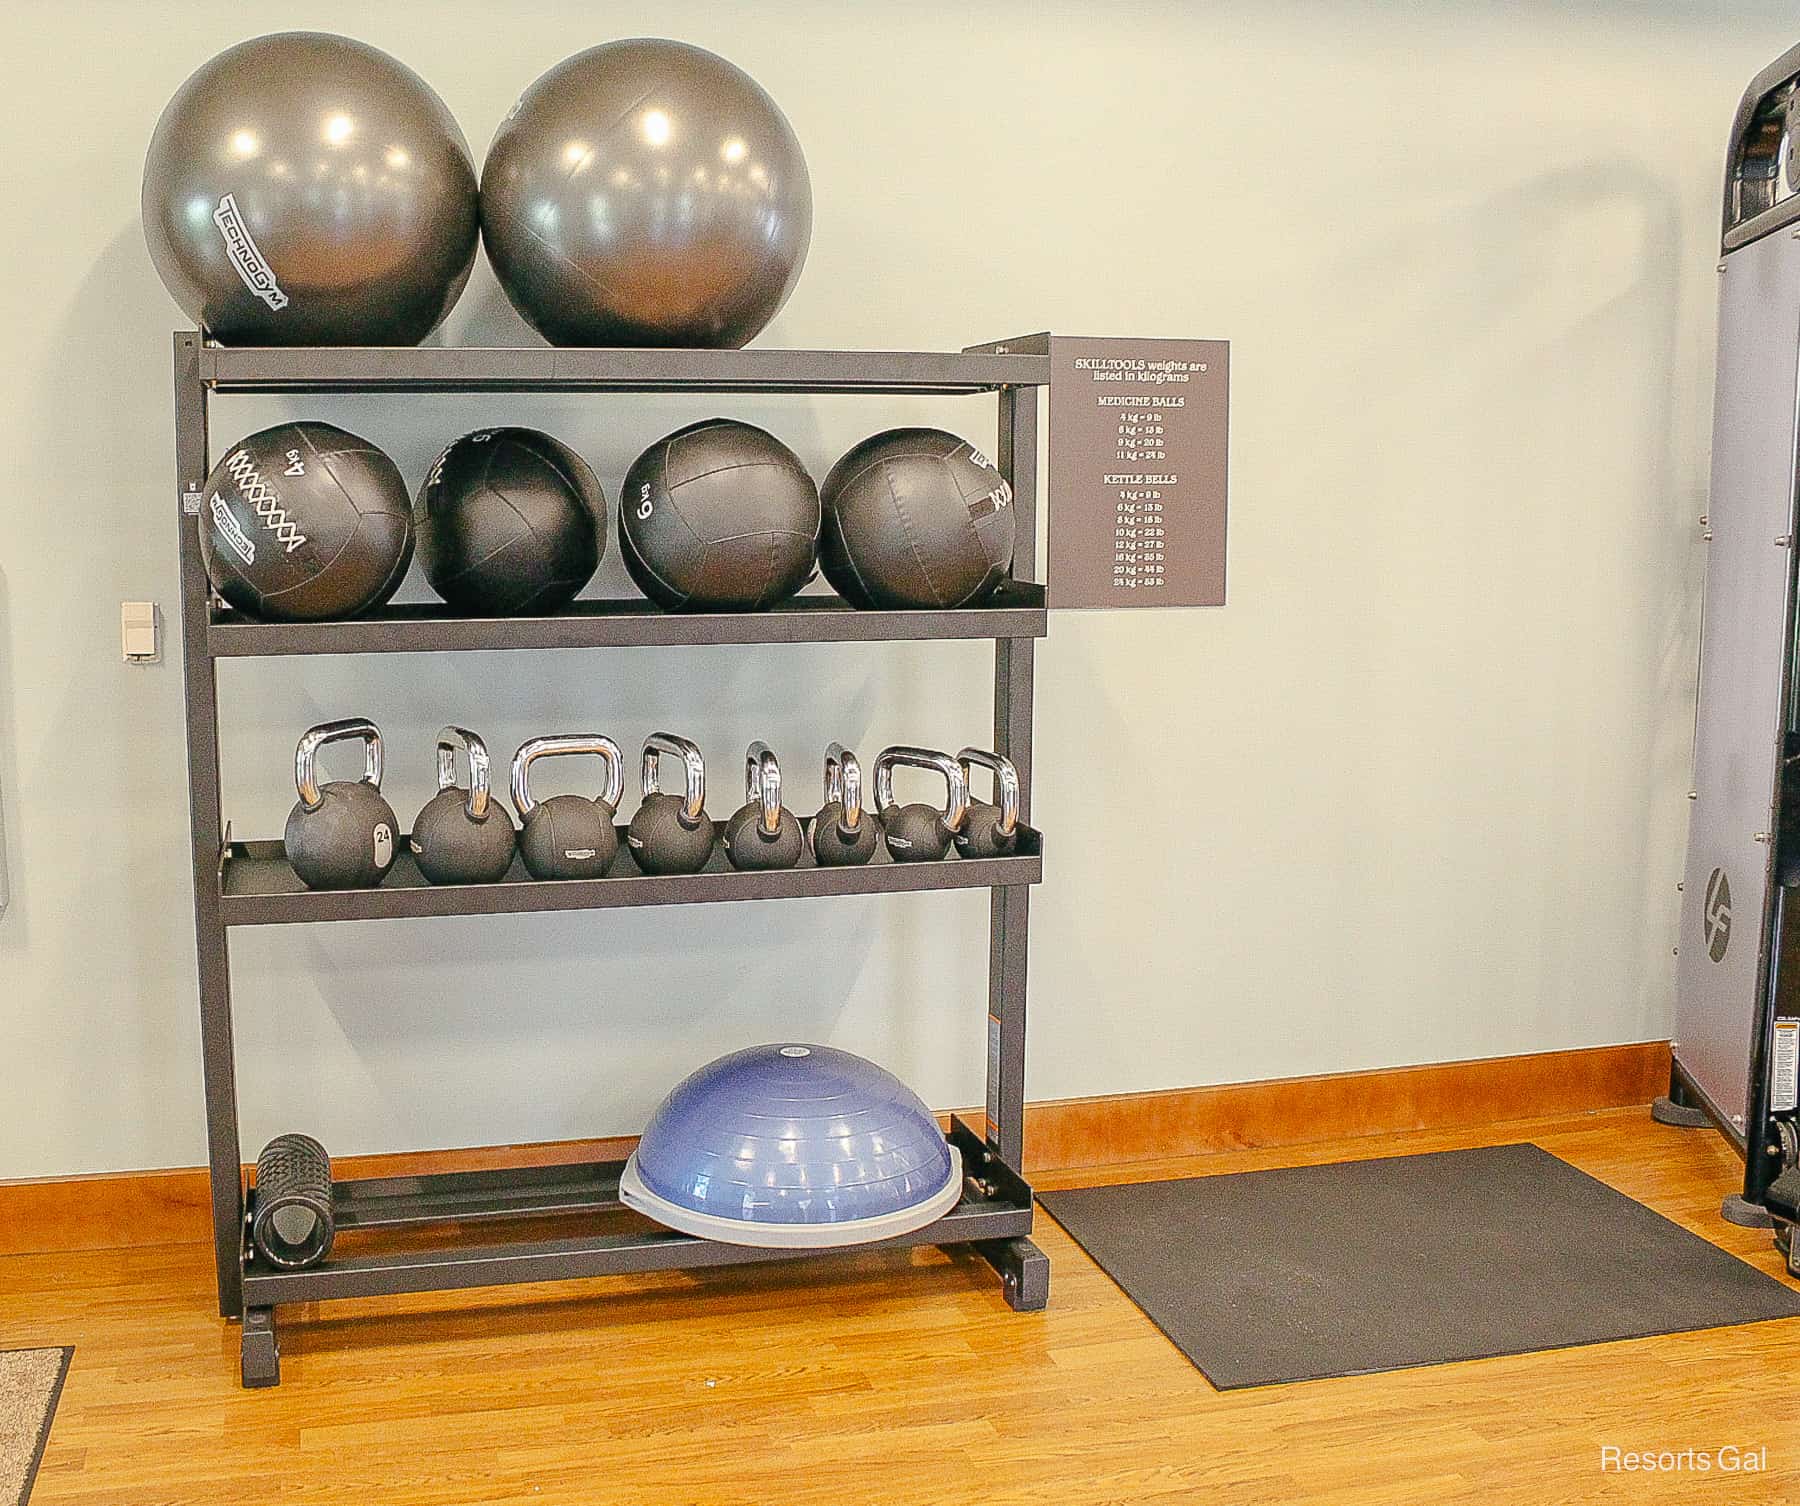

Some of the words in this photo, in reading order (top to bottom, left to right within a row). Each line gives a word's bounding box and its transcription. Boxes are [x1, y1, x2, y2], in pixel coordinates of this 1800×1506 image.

[217, 198, 284, 306] TECHNOGYM
[1075, 358, 1146, 371] SKILLTOOLS
[1147, 359, 1188, 373] weights
[1189, 361, 1208, 373] are
[1093, 370, 1123, 382] listed
[1124, 370, 1136, 381] in
[1137, 371, 1190, 385] kilograms
[1097, 396, 1151, 407] MEDICINE
[1151, 396, 1185, 407] BALLS
[1127, 413, 1139, 424] kg
[1153, 413, 1162, 422] lb
[1125, 425, 1137, 436] kg
[1155, 425, 1164, 434] lb
[1124, 438, 1137, 449] kg
[1143, 438, 1155, 447] 20
[1155, 438, 1164, 447] lb
[1116, 450, 1125, 460] 11
[1126, 450, 1138, 462] kg
[1157, 450, 1166, 460] lb
[1103, 474, 1144, 485] KETTLE
[1145, 474, 1178, 485] BELLS
[1126, 490, 1138, 501] kg
[1152, 490, 1161, 499] lb
[1116, 503, 1124, 512] 6
[1124, 503, 1136, 514] kg
[1154, 503, 1163, 512] lb
[1124, 515, 1136, 526] kg
[1154, 515, 1163, 524] lb
[1115, 528, 1125, 537] 10
[1125, 528, 1137, 539] kg
[1144, 528, 1155, 537] 22
[1155, 528, 1165, 537] lb
[1115, 540, 1125, 549] 12
[1125, 540, 1137, 551] kg
[1143, 540, 1155, 549] 27
[1155, 540, 1165, 549] lb
[1125, 553, 1137, 564] kg
[1155, 553, 1165, 562] lb
[1113, 565, 1125, 574] 20
[1125, 565, 1137, 576] kg
[1155, 565, 1165, 574] lb
[1125, 577, 1137, 589] kg
[1155, 577, 1165, 587] lb
[376, 829, 390, 843] 24
